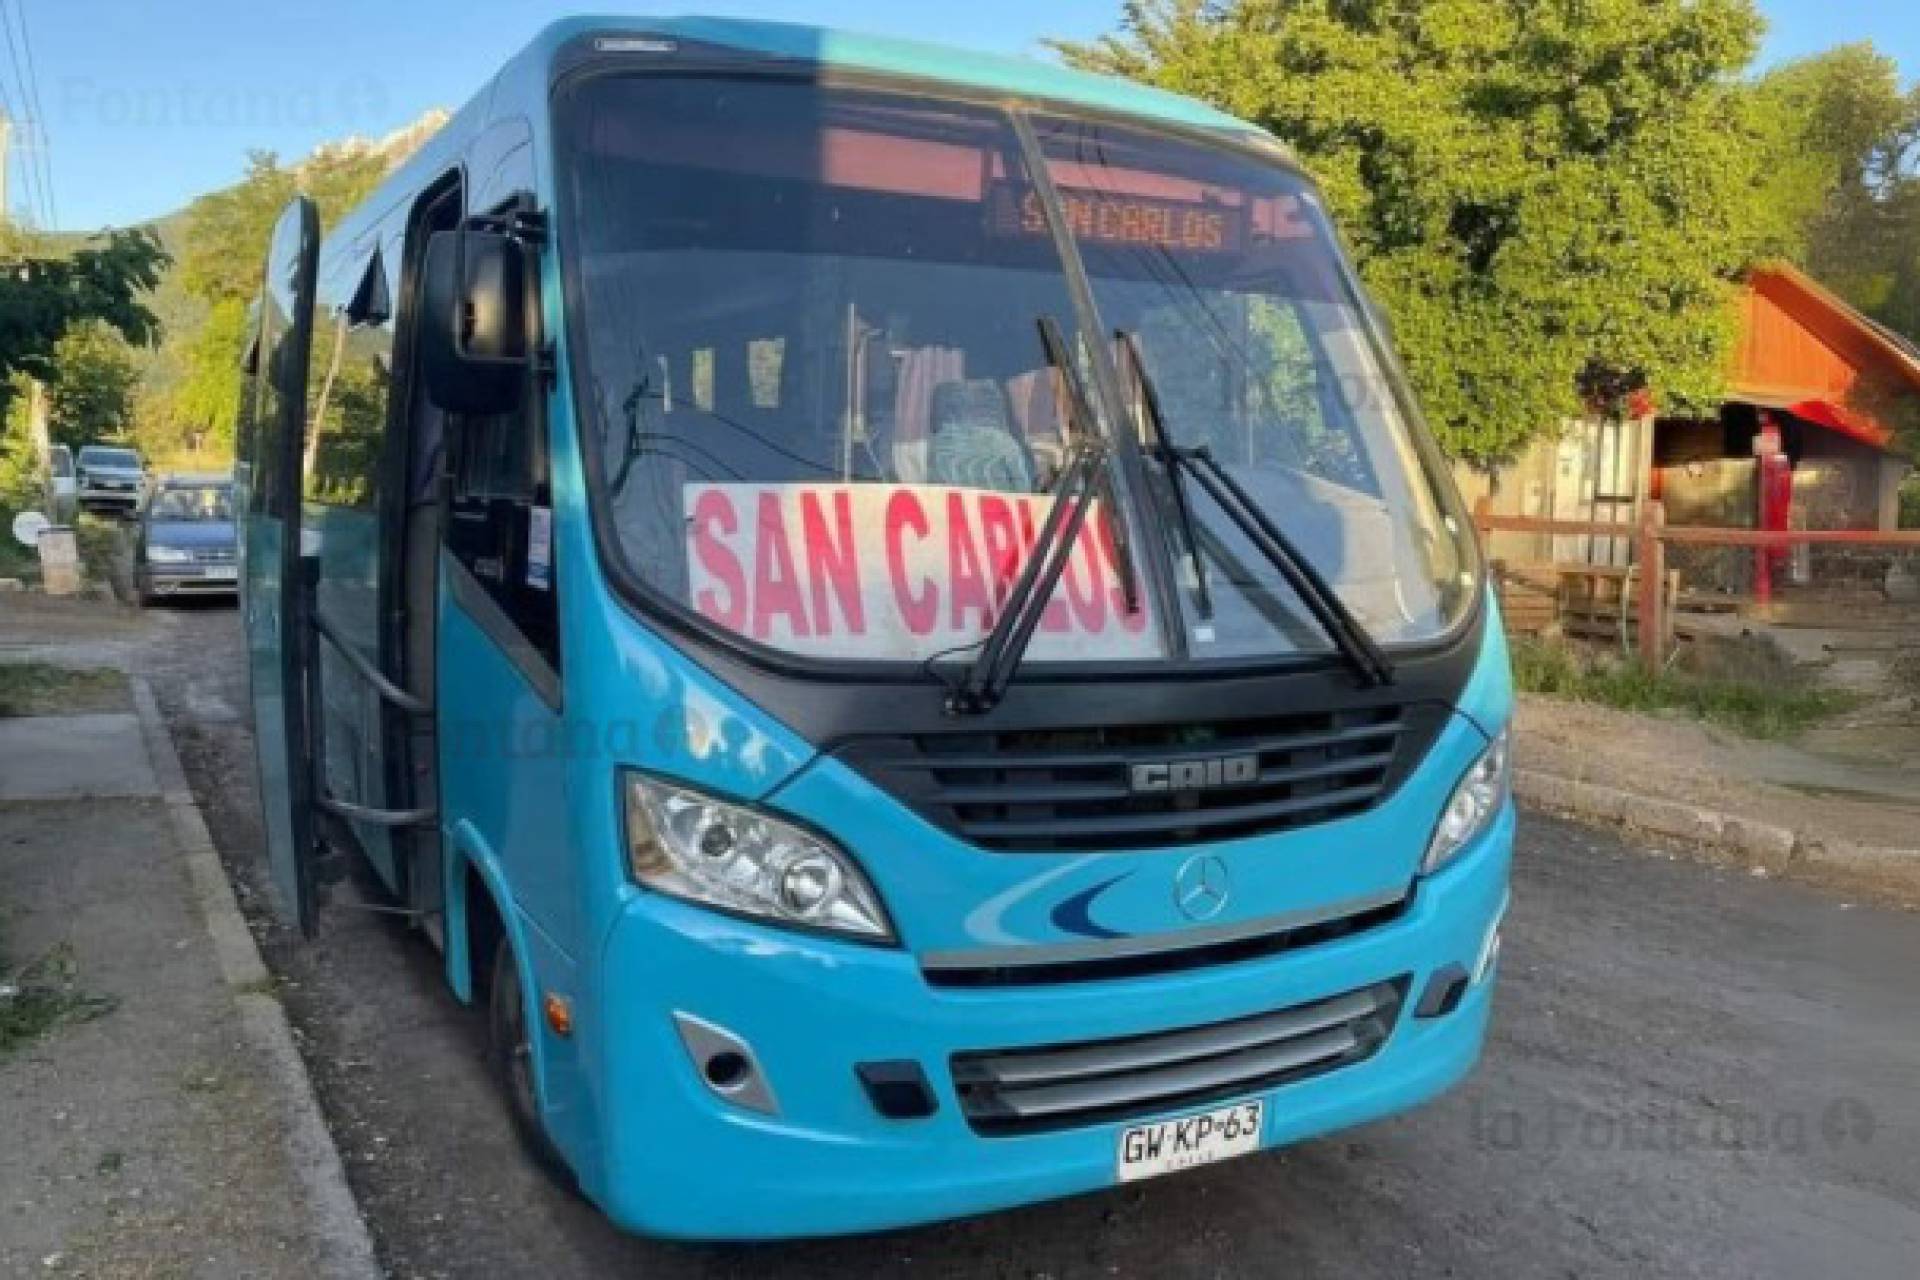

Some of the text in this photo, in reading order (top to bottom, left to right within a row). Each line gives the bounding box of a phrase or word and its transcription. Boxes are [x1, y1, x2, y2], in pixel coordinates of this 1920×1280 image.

[1099, 201, 1223, 249] CARLOS
[692, 489, 866, 640] SAN
[1131, 757, 1257, 791] CAIO
